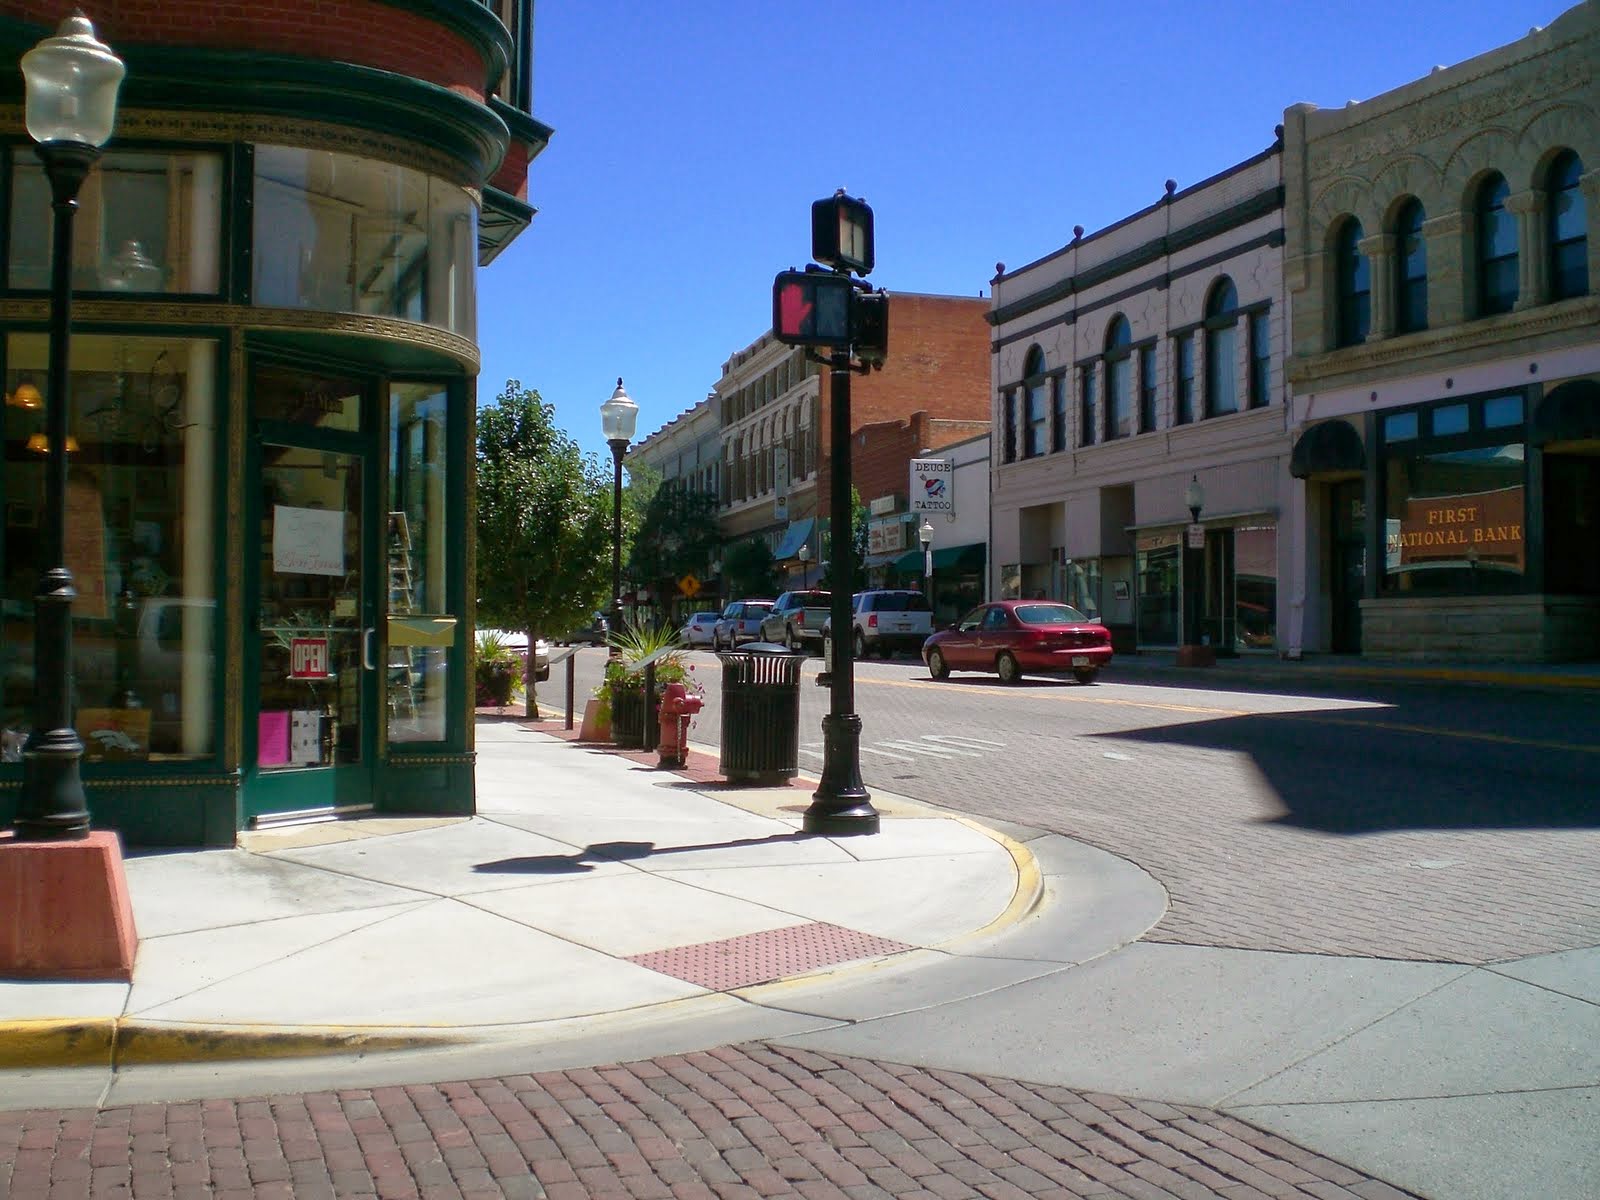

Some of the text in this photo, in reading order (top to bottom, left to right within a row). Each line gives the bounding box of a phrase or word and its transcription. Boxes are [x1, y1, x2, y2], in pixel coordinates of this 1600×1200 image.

[915, 463, 951, 472] DEUCE
[915, 501, 951, 510] TATTOO
[1428, 508, 1477, 525] FIRST
[1389, 526, 1522, 547] NATIONAL BANK
[294, 644, 326, 673] OPEN
